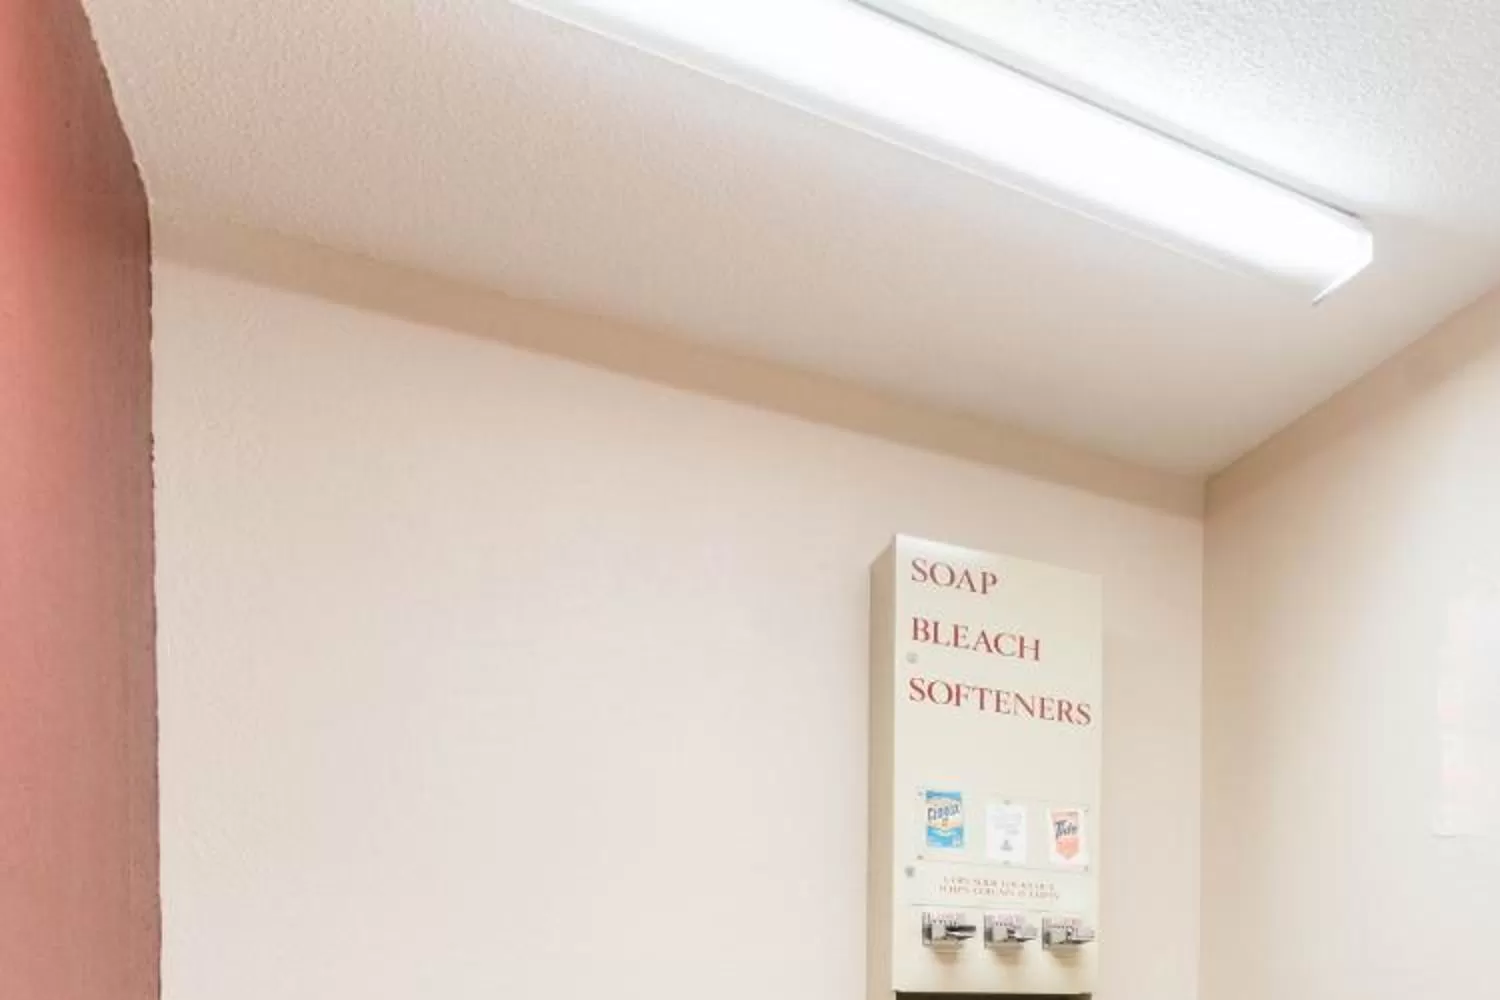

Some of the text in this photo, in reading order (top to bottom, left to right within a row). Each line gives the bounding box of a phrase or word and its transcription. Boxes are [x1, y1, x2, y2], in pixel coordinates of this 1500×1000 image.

[911, 558, 998, 595] SOAP
[912, 616, 1041, 662] BLEACH
[909, 677, 1092, 726] SOFTENERS
